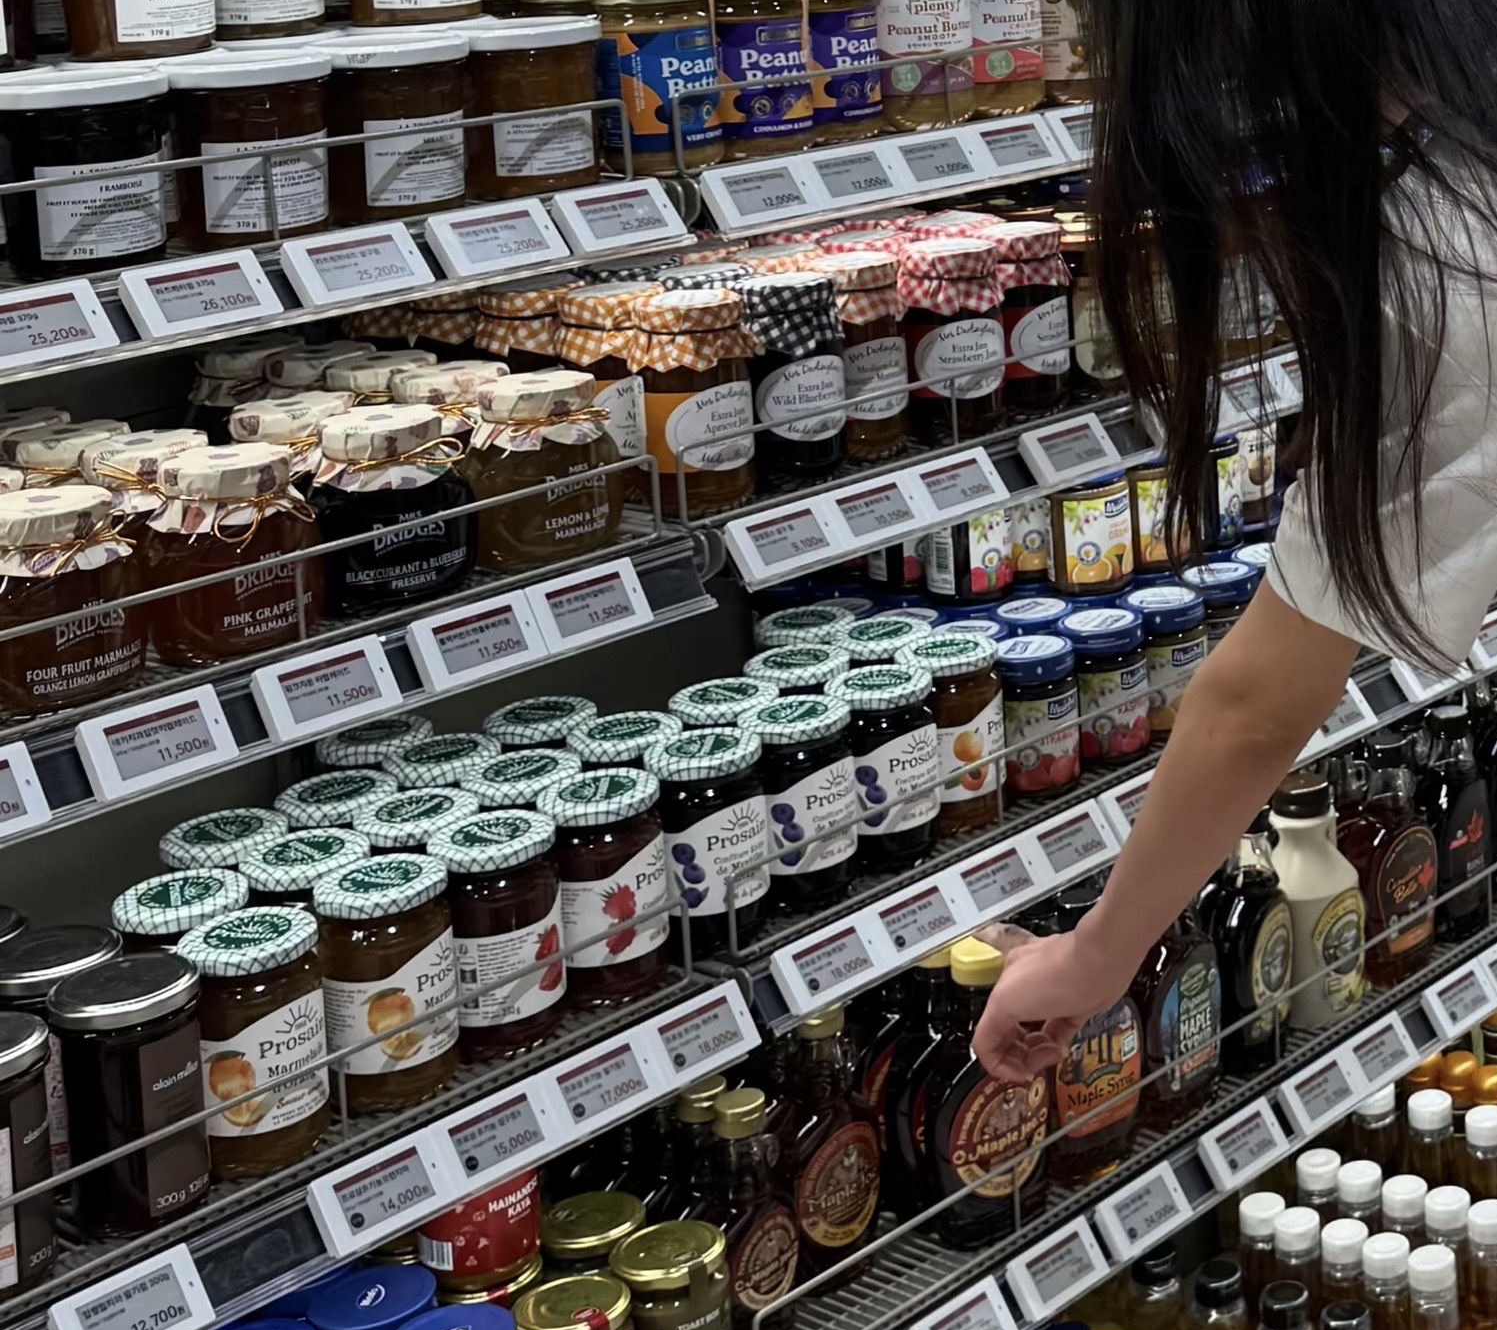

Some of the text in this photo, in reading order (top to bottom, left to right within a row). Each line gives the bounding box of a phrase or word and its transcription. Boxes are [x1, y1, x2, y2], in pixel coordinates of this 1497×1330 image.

[983, 12, 1027, 26] Peanut
[887, 21, 938, 37] Peanut
[73, 246, 87, 256] 370
[939, 350, 984, 366] Strawberry
[772, 394, 797, 407] Wild
[569, 463, 590, 475] MRS
[400, 510, 423, 523] MRS
[545, 515, 578, 531] LEMON
[373, 520, 446, 553] BRIDGES
[345, 561, 421, 583] BLACKCURRANT
[430, 546, 467, 568] BLUEBERRY
[391, 571, 437, 590] PRESERVE
[223, 611, 253, 629] PINK
[26, 638, 142, 683] FOUR FRUIT MARMALADE
[32, 680, 69, 696] ORANGE
[69, 672, 95, 688] LEMON
[327, 685, 375, 708] 11,500원
[158, 738, 210, 763] 11,500원
[1180, 1010, 1212, 1040] MAPLE
[1067, 1089, 1105, 1110] Maple
[969, 1126, 1016, 1160] Maple
[156, 1192, 178, 1209] 300
[380, 1184, 430, 1214] 14,000원
[507, 1198, 532, 1218] KAYA
